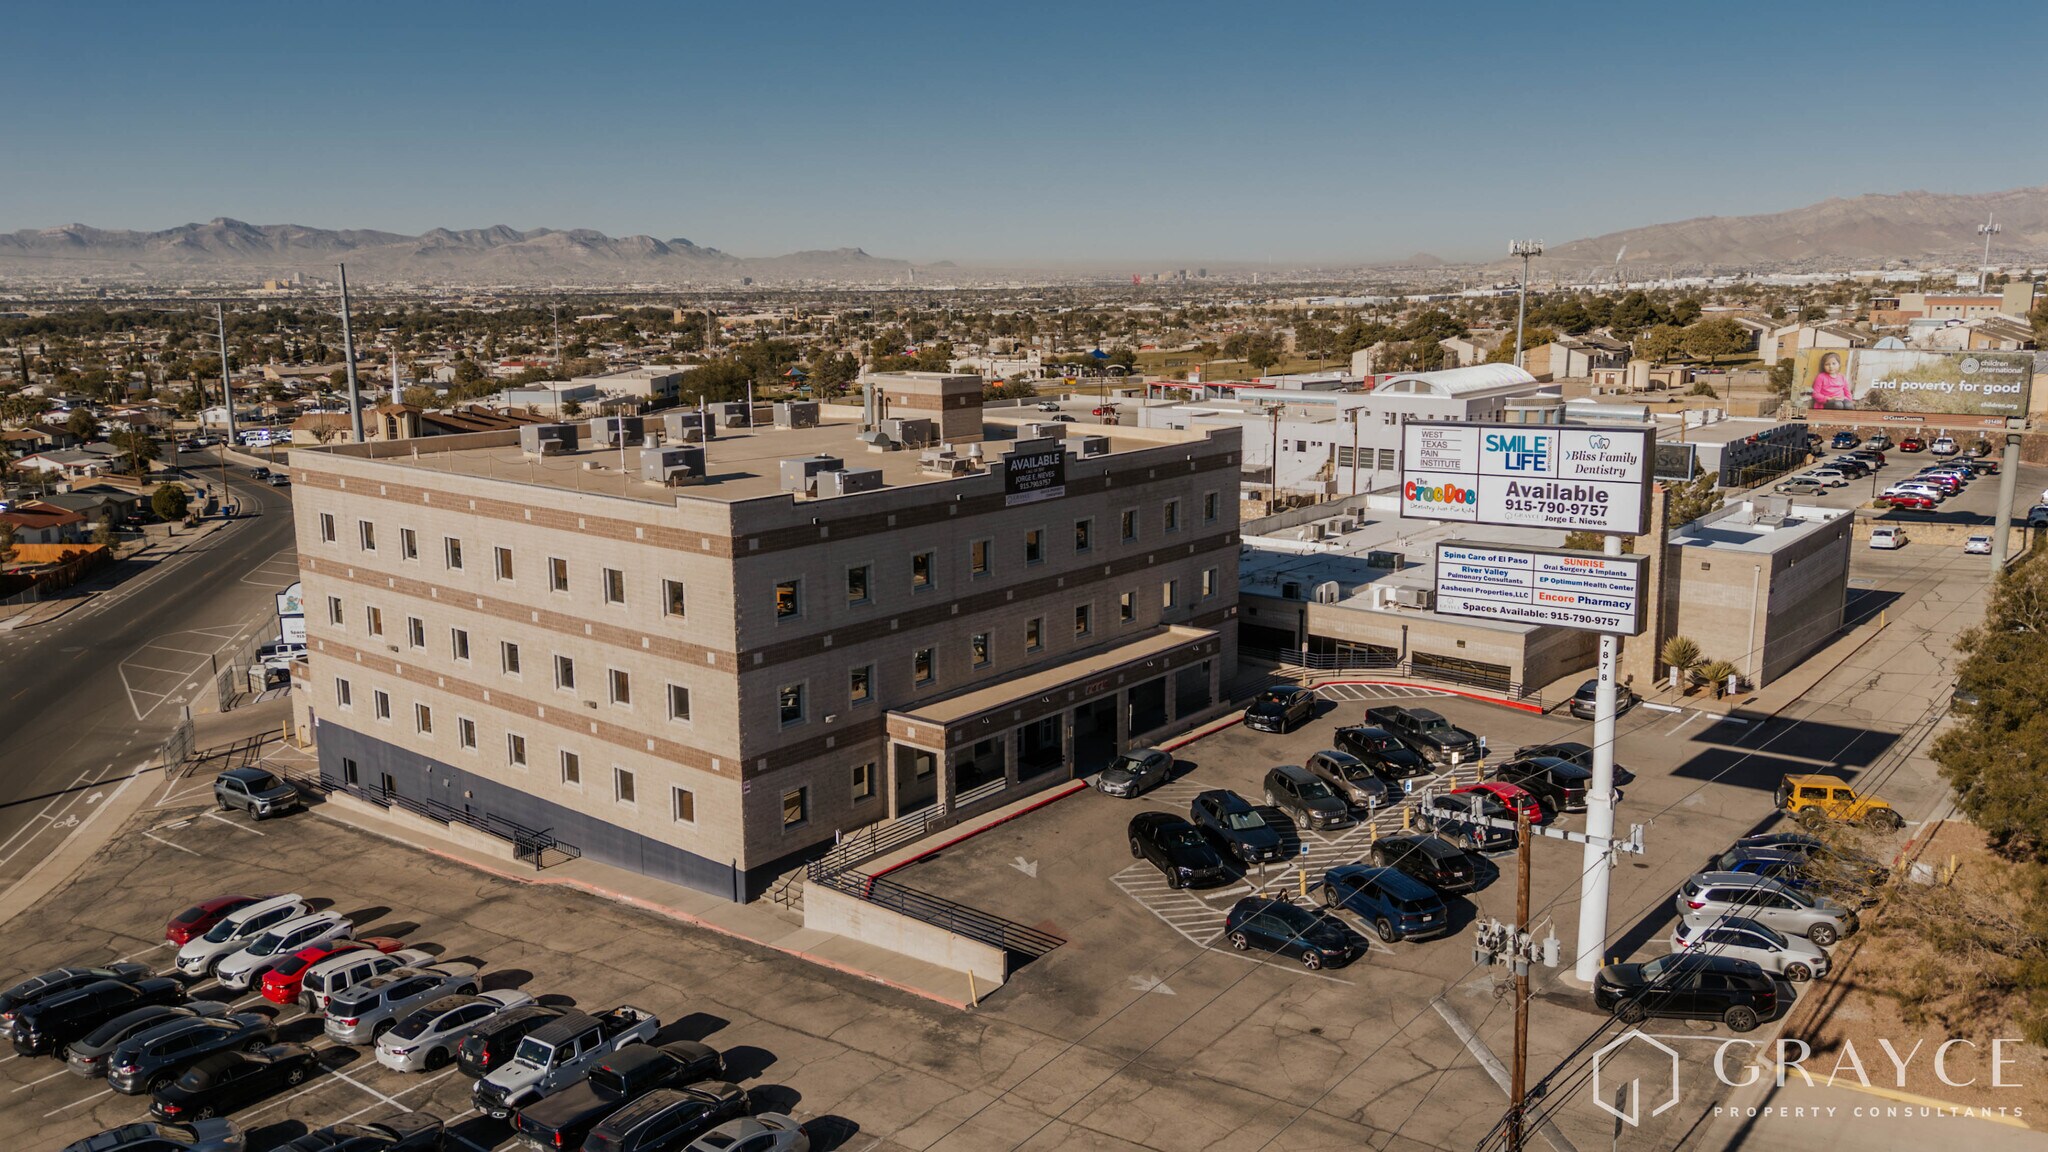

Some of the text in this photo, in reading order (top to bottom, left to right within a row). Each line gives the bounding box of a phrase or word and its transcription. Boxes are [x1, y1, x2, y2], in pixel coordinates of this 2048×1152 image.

[1871, 378, 2021, 395] End poverty for good
[1980, 402, 2018, 410] children.org
[1421, 441, 1448, 449] TEXAS
[1486, 434, 1547, 453] SMILE
[1010, 453, 1060, 471] AVAILABLE
[1420, 460, 1461, 468] INSTITUTE
[1505, 452, 1546, 472] LIFE
[1571, 450, 1637, 466] Bliss Family
[1575, 464, 1627, 477] Dentistry
[1416, 477, 1428, 485] The
[1505, 481, 1609, 503] Available
[1505, 499, 1609, 517] 915-790-9757
[1544, 515, 1607, 526] Jorge E. Nieves
[1444, 551, 1466, 560] Spine
[1468, 553, 1486, 561] Care
[1508, 556, 1528, 564] Paso
[1563, 558, 1605, 568] SUNRISE
[1461, 565, 1508, 577] River Valley
[1559, 565, 1587, 574] Surgery
[1595, 568, 1627, 577] Implants
[1447, 572, 1523, 584] Pulmonary Consultants
[1550, 577, 1582, 586] Optimum
[1583, 581, 1607, 589] Health
[1609, 583, 1634, 591] Center
[1538, 591, 1631, 610] Encore Pharmacy
[1462, 602, 1497, 613] Spaces
[1499, 606, 1548, 618] Available:
[1550, 611, 1620, 627] 915-790-9757
[1601, 640, 1609, 681] 7878
